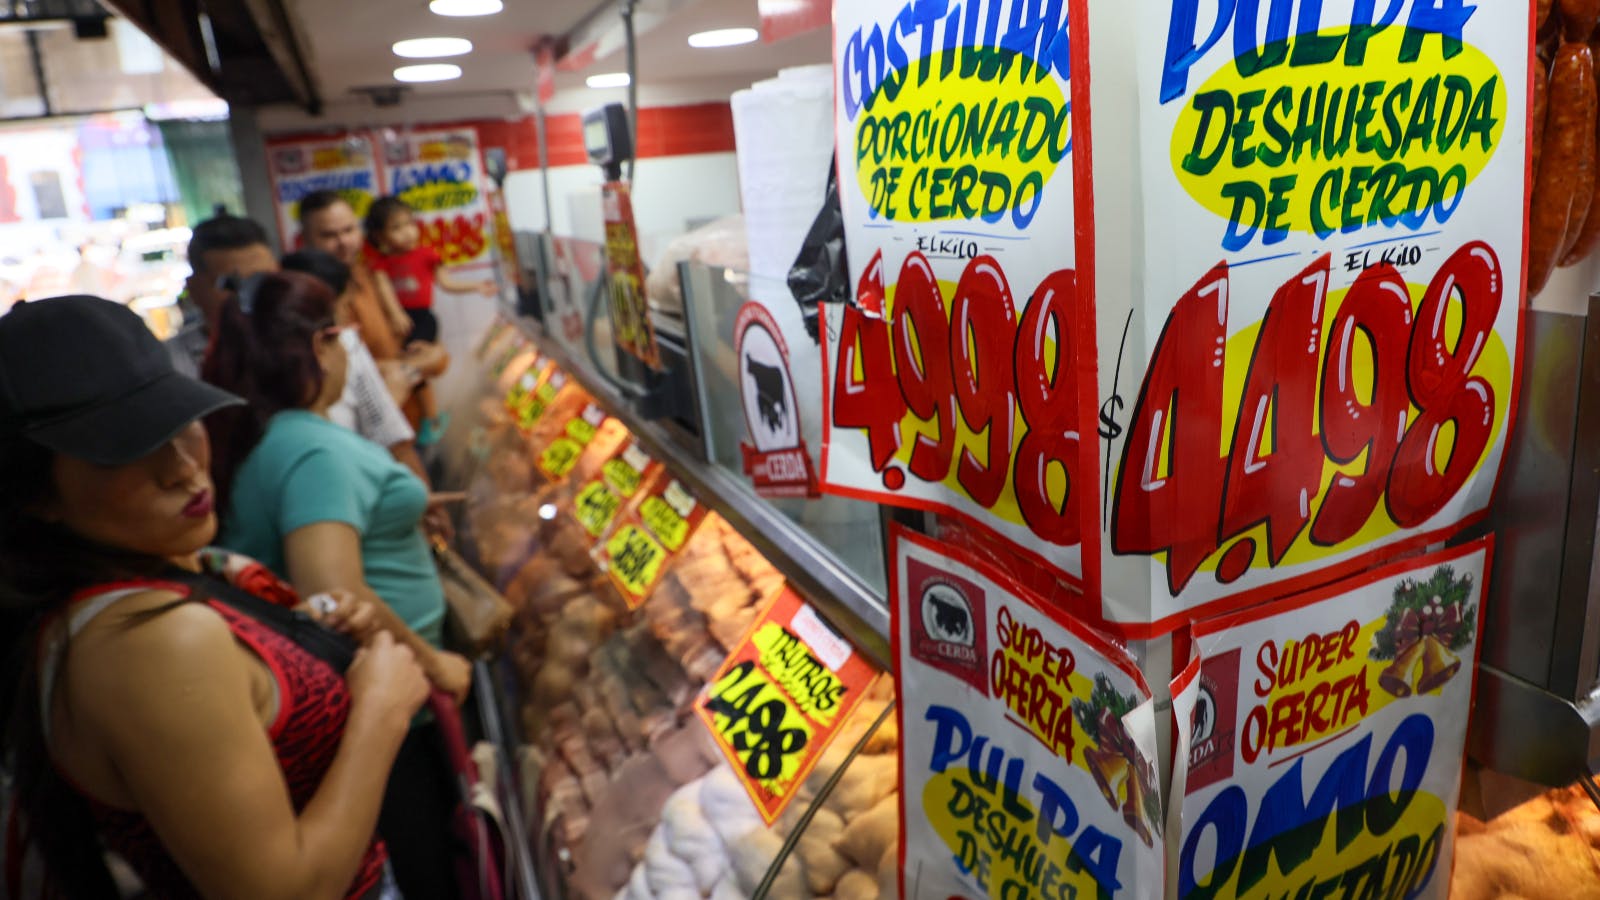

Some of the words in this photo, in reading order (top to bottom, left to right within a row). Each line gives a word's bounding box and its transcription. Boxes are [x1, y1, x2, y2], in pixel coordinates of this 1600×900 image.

[1182, 74, 1498, 176] DESHUESADA
[868, 166, 903, 220] DE
[908, 164, 1043, 230] CERDO
[916, 236, 938, 252] EL
[1221, 174, 1297, 252] DE
[1310, 162, 1466, 240] CERDO
[1344, 249, 1376, 272] EL
[833, 248, 1081, 546] 4.998
[1097, 308, 1133, 533] $
[1111, 240, 1503, 597] 4.498
[771, 626, 848, 711] TRUTROS
[997, 605, 1076, 693] SUPER
[1254, 619, 1361, 698] SUPER
[990, 649, 1076, 766] OFERTA
[1241, 664, 1371, 764] OFERTA
[925, 703, 1123, 900] PULPA
[1178, 713, 1434, 900] OMO
